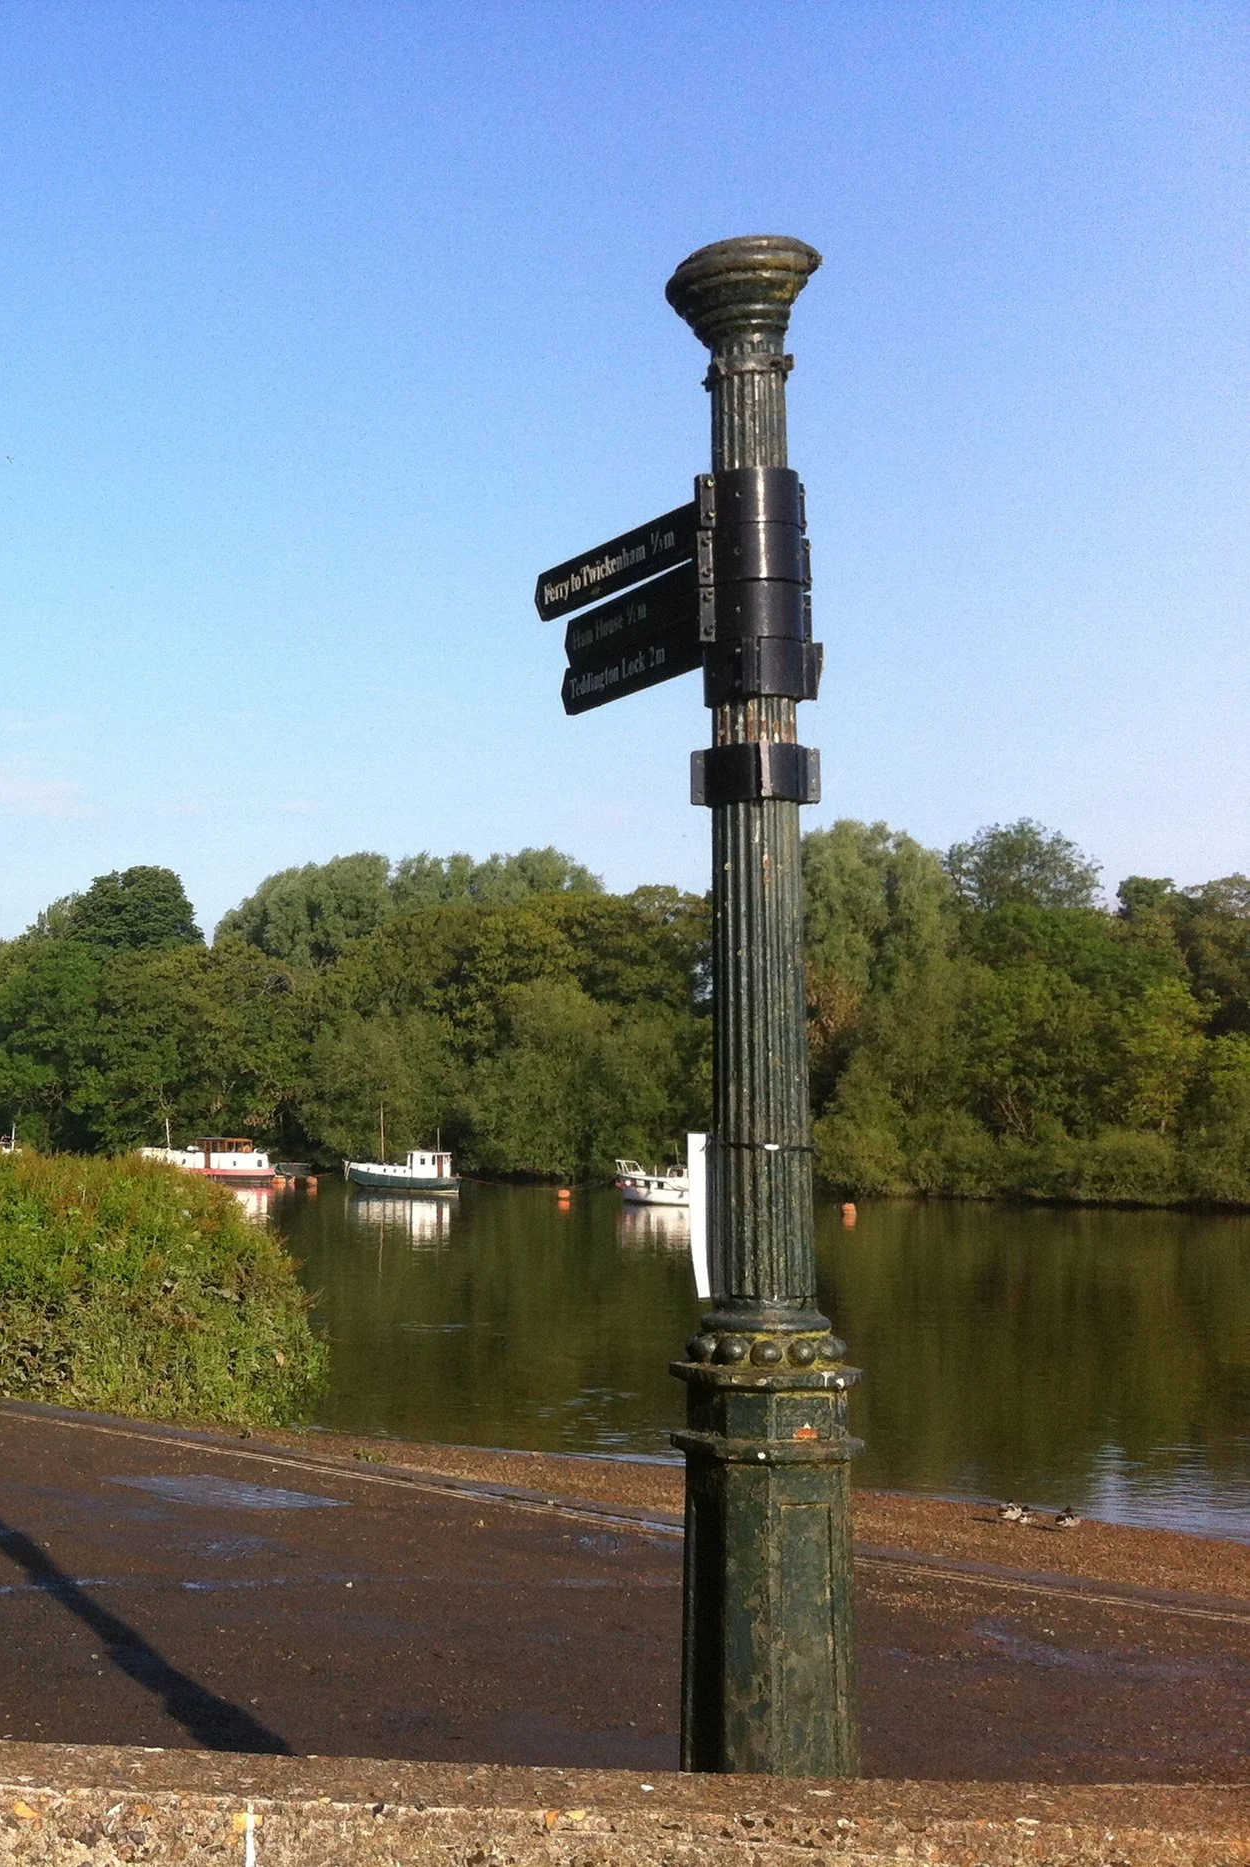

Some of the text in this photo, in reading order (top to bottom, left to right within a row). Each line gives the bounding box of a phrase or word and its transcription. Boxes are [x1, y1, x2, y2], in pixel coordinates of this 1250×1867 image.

[544, 582, 570, 605] Ferry
[571, 573, 581, 593] to
[580, 544, 646, 587] Twickenham
[569, 665, 620, 699] Teddington
[622, 650, 645, 679] Lock
